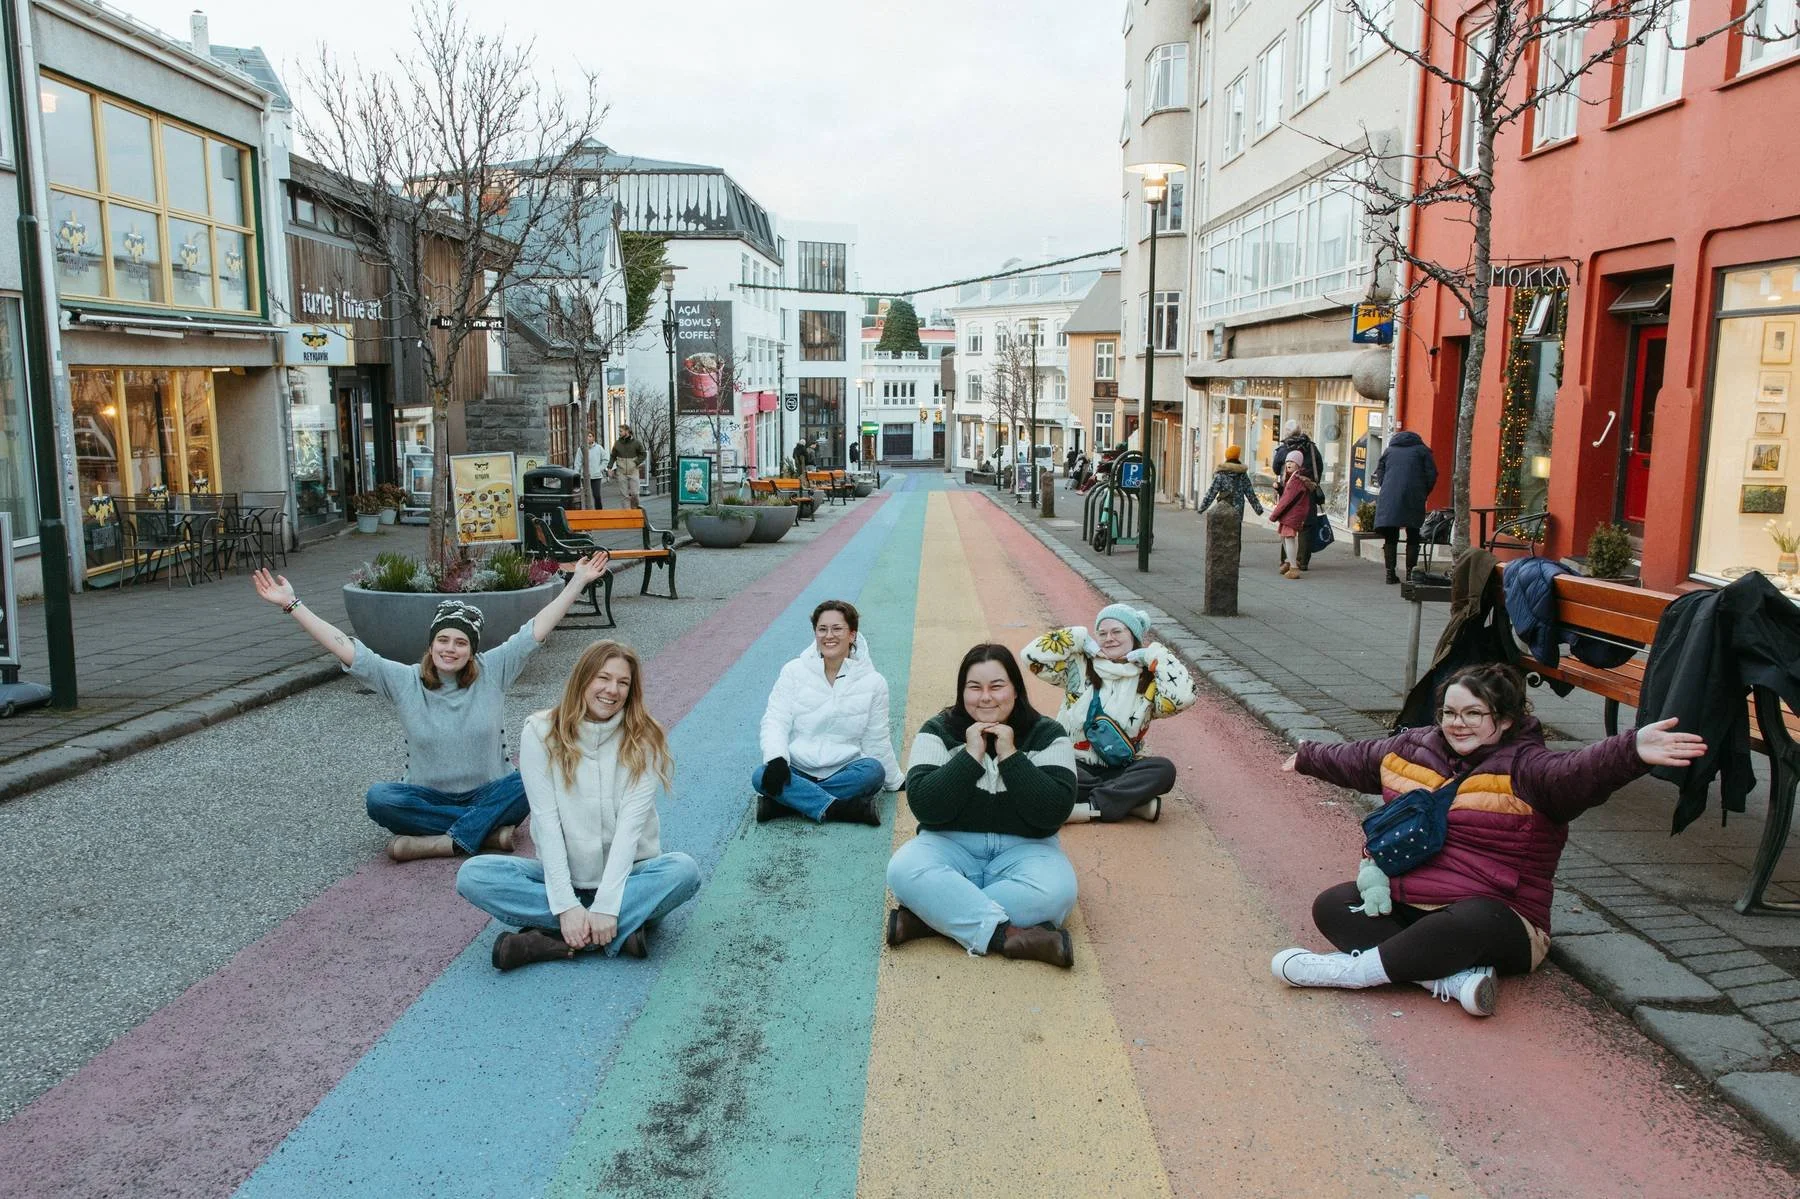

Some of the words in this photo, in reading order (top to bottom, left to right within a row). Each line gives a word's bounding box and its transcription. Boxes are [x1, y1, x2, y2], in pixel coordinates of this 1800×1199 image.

[1490, 265, 1567, 289] MOKKA
[301, 284, 333, 316] iurie
[342, 291, 365, 319] fine
[367, 300, 383, 320] art
[678, 304, 700, 316] AÇAÍ
[679, 318, 712, 327] BOWLS
[679, 331, 715, 340] COFFEE
[1130, 464, 1139, 476] P
